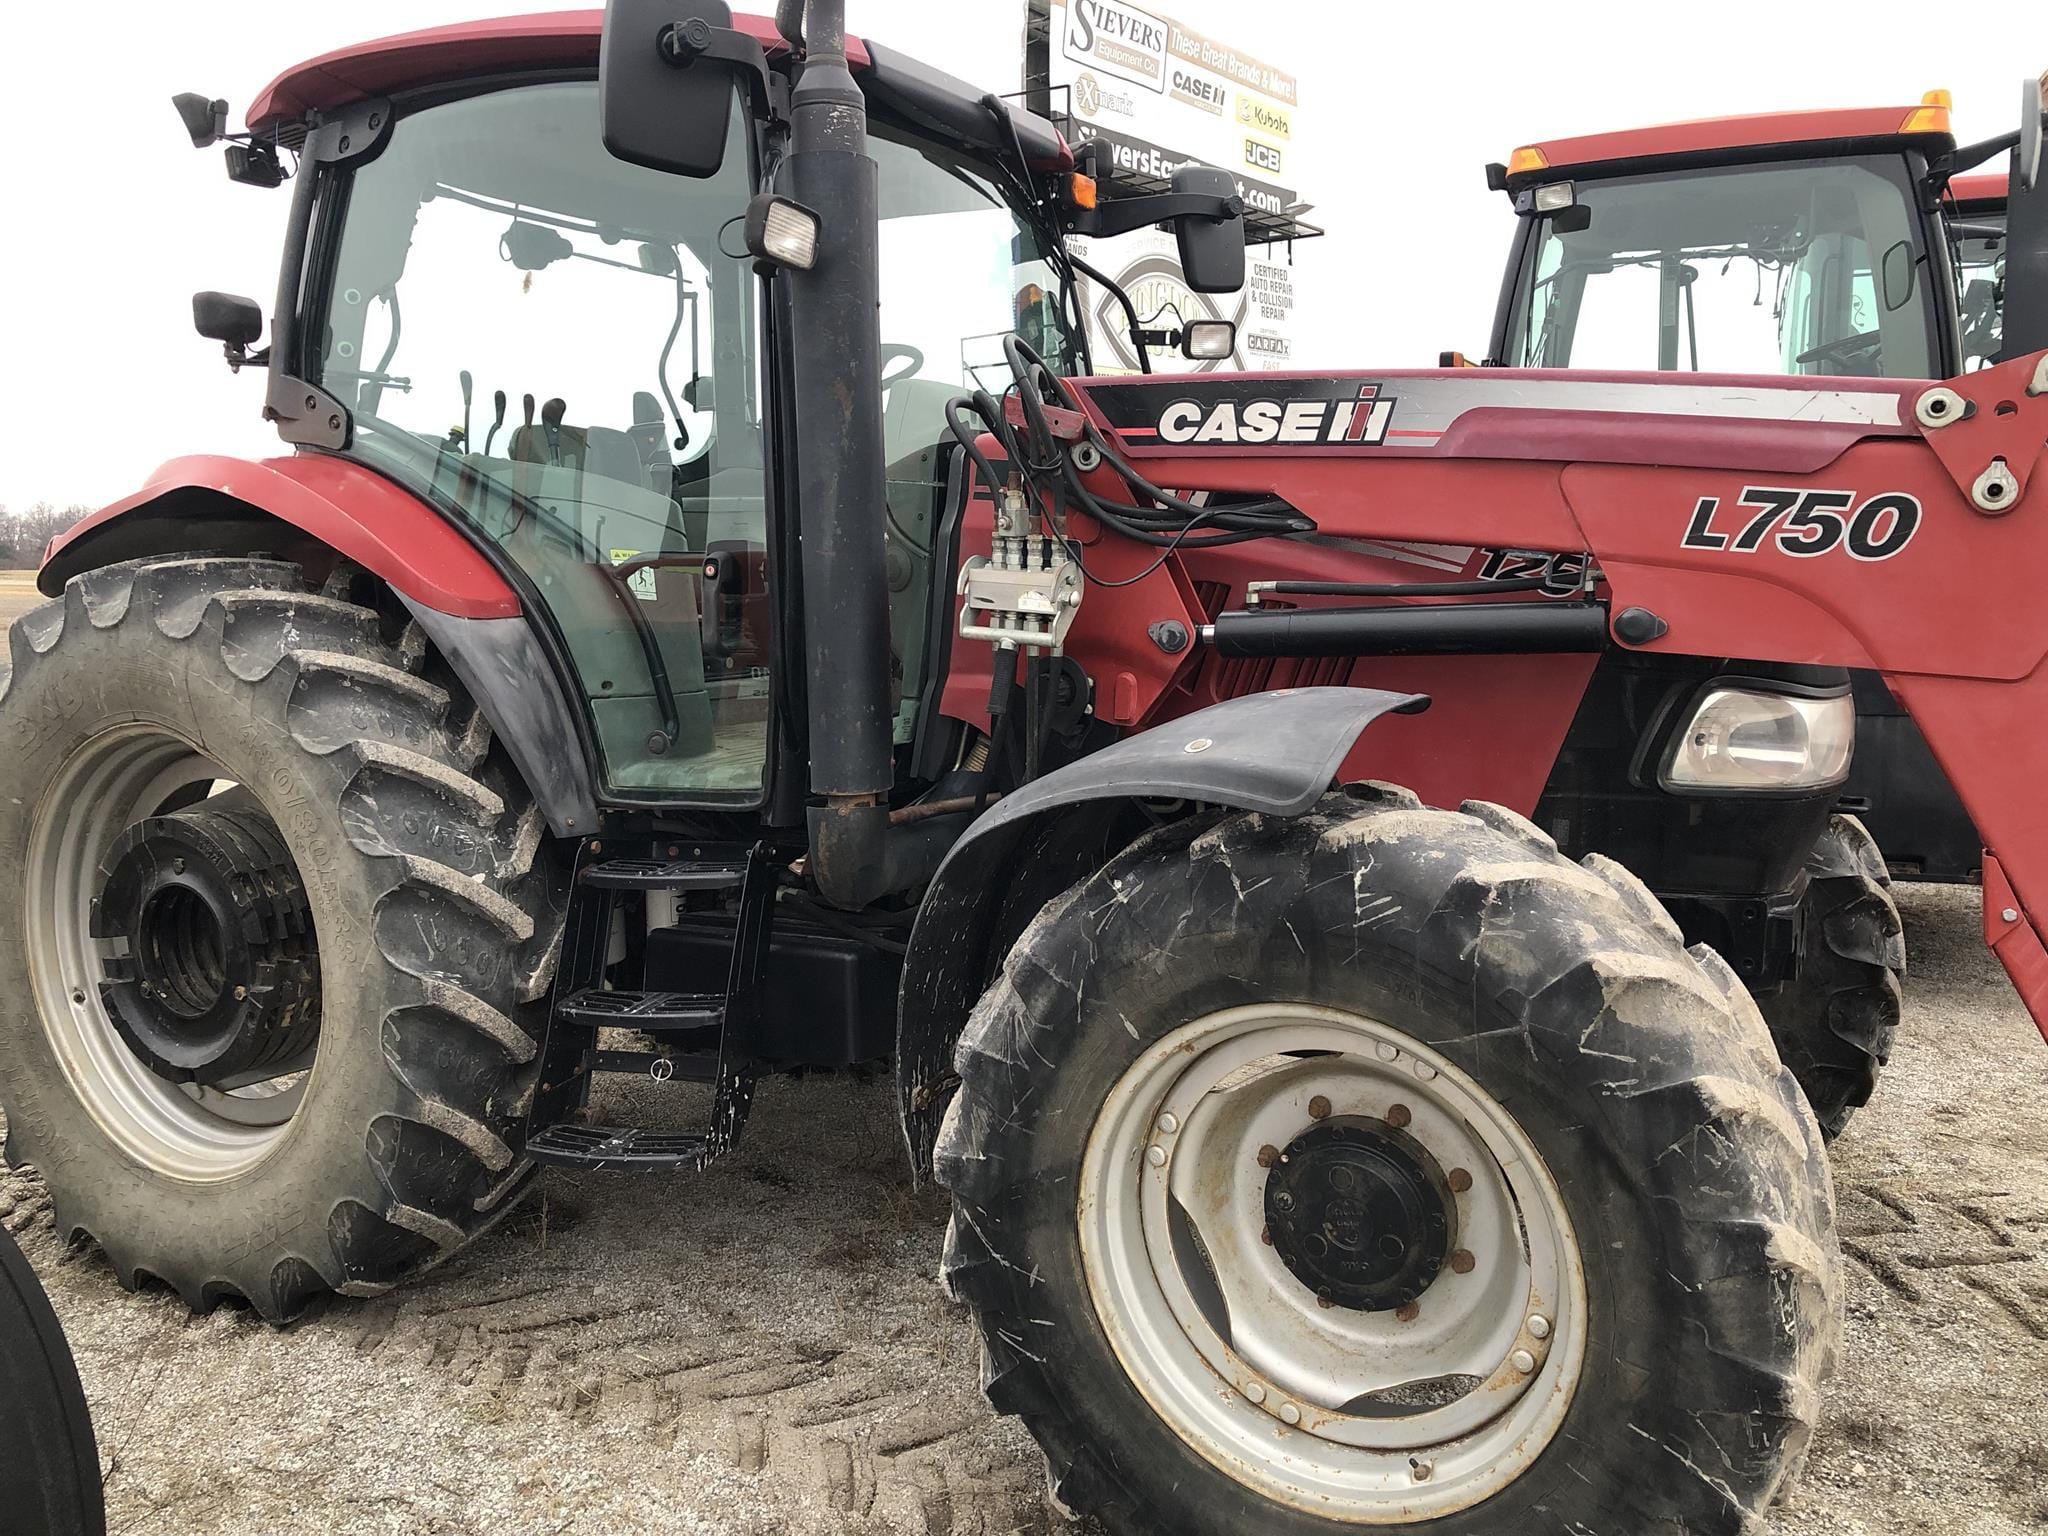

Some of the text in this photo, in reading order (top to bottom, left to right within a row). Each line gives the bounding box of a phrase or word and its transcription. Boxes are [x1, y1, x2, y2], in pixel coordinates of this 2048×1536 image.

[1070, 0, 1162, 52] SIEVERS
[1099, 41, 1158, 75] Equipment Co.
[1171, 27, 1200, 58] These
[1202, 41, 1227, 70] Great
[1228, 54, 1261, 84] Brands
[1269, 71, 1296, 100] More!
[1172, 71, 1212, 100] CASE
[1254, 106, 1289, 134] Kubota
[1246, 140, 1280, 173] JCB
[1066, 243, 1088, 256] ANDS
[1250, 276, 1293, 296] AUTO REPAIR
[1254, 264, 1288, 281] CERTIFIED
[1251, 290, 1293, 309] & COLLISION
[1260, 306, 1285, 320] REPAIR
[1248, 334, 1291, 356] CARFAX
[1159, 401, 1327, 442] CASE
[1680, 485, 1923, 562] L750
